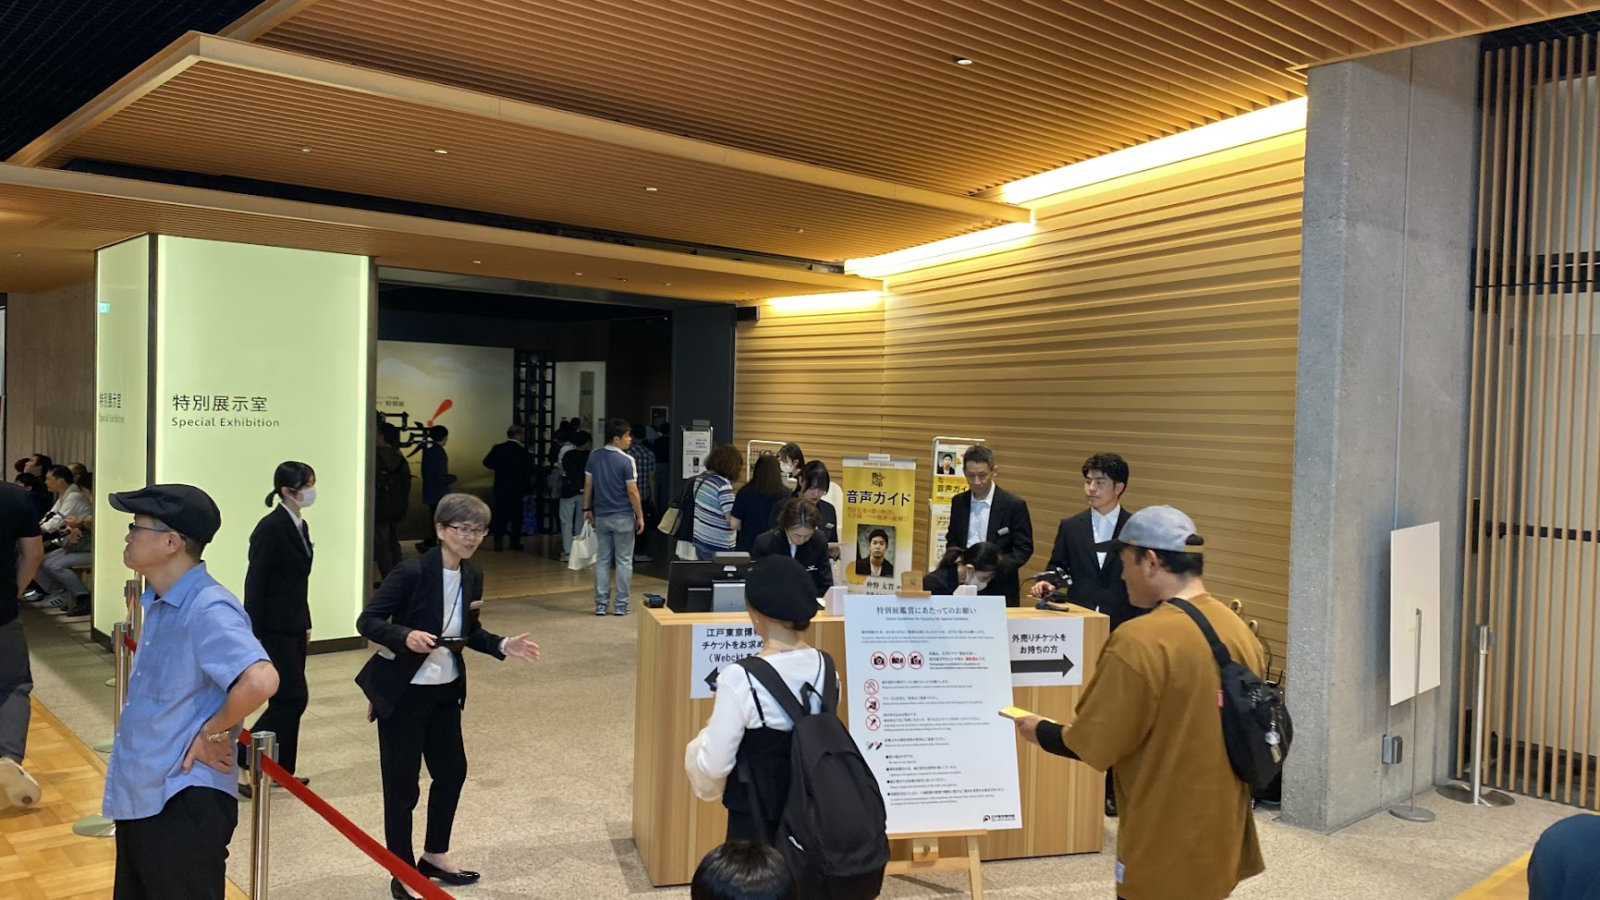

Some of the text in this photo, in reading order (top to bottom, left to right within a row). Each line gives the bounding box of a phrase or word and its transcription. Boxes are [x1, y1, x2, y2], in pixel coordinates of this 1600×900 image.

[172, 394, 268, 412] 特別展示室
[171, 417, 280, 428] Special Exhibition
[846, 489, 912, 506] 音声ガイド
[876, 606, 977, 615] 特別展鑑賞にあたってのお願い
[1012, 633, 1067, 643] 外売りチケットを
[702, 640, 765, 650] チケットをお求め
[1019, 645, 1058, 654] お持ちの方
